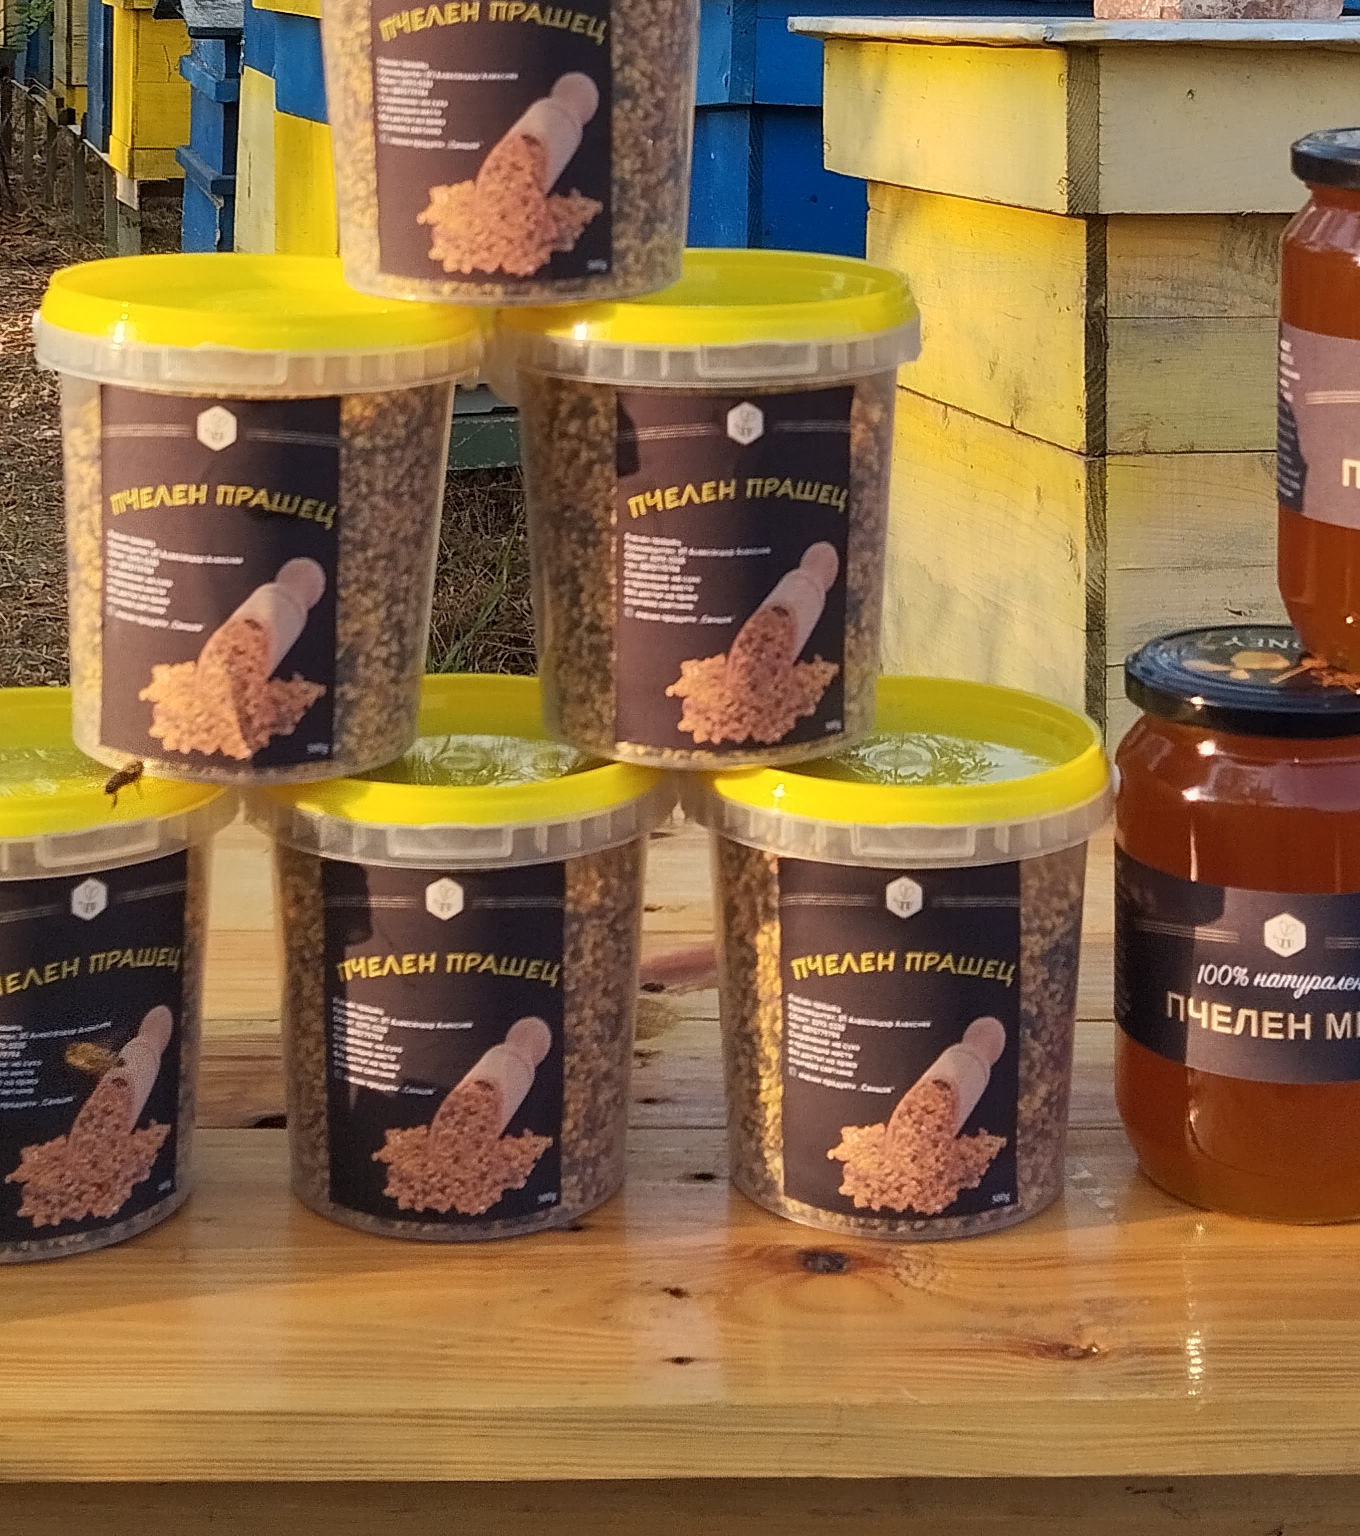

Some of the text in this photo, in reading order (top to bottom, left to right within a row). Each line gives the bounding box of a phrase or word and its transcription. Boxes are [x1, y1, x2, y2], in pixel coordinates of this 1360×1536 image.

[379, 0, 608, 46] ПЧЕЛЕН ПРАШЕЦ
[109, 484, 337, 531] ПЧЕЛЕН ПРАШЕЦ
[627, 478, 849, 518] ПЧЕЛЕН ПРАШЕЦ
[89, 947, 181, 974] ПРАШЕЦ
[338, 952, 561, 987] ПЧЕЛЕН ПРАШЕЦ
[791, 951, 1016, 987] ПЧЕЛЕН ПРАШЕЦ
[1197, 964, 1249, 987] 100%
[1167, 990, 1311, 1040] ПЧЕЛЕН
